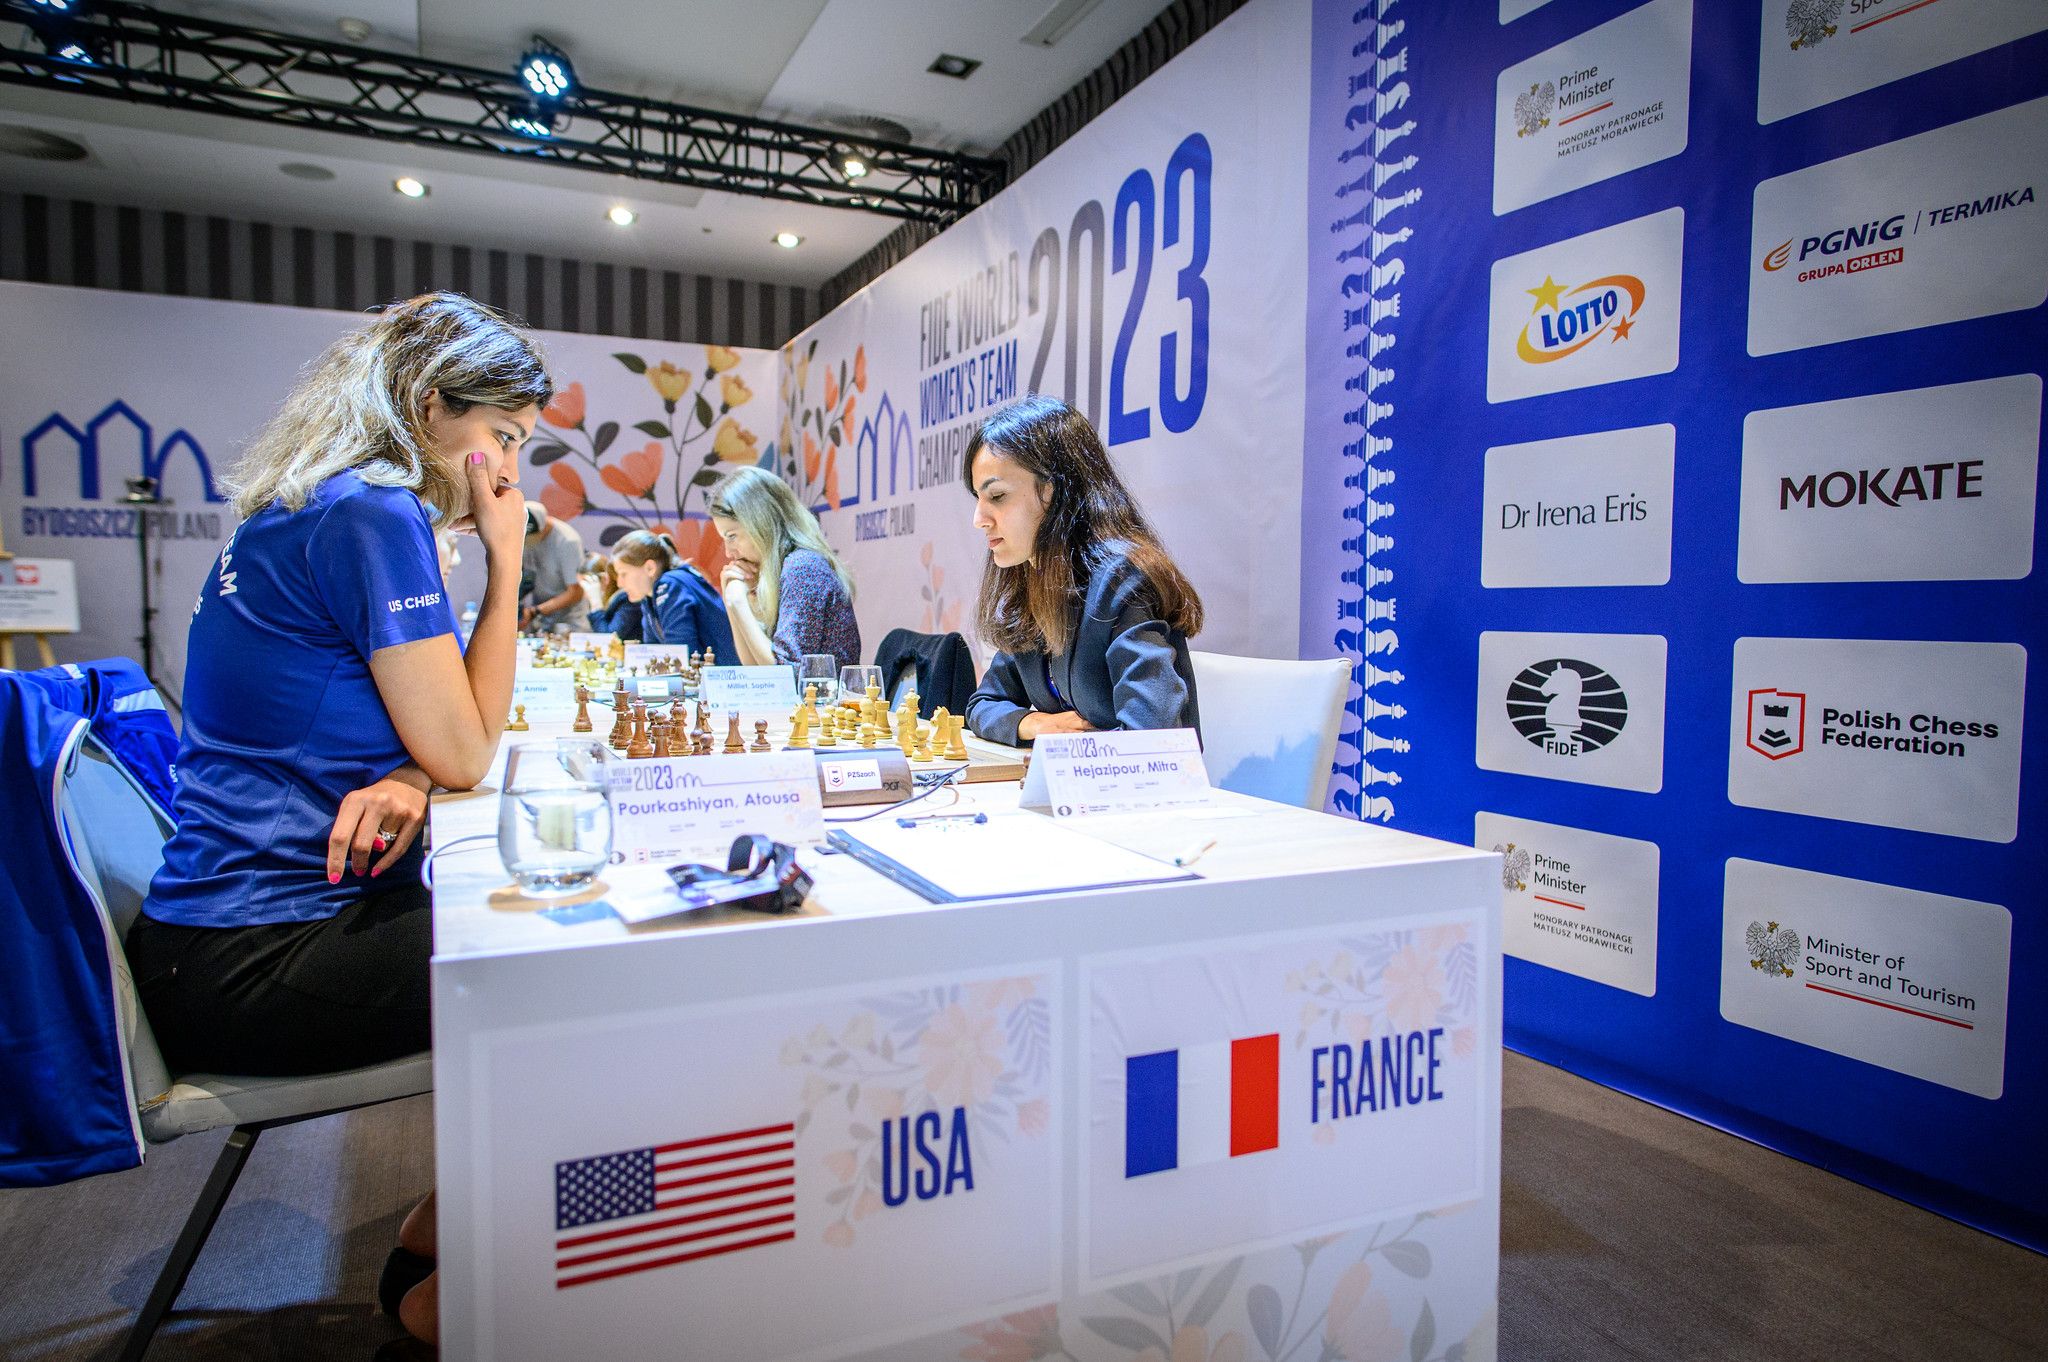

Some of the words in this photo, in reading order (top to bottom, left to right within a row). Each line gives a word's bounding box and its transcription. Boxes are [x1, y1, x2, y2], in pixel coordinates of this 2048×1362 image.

[1559, 78, 1615, 110] Minister
[1560, 66, 1598, 90] Prime
[1558, 124, 1606, 147] HONORARY
[1608, 101, 1664, 129] PATRONAGE
[1558, 137, 1598, 158] MATEUSZ
[1601, 112, 1664, 142] MORAWIECKI
[1799, 214, 1905, 262] PGNiG
[1928, 186, 2035, 227] TERMIKA
[1797, 263, 1845, 283] GRUPA
[1849, 250, 1901, 272] ORLEN
[1029, 131, 1213, 447] 2023
[920, 291, 950, 371] FIDE
[957, 250, 1020, 349] WORLD
[1541, 290, 1618, 348] LOTTO
[919, 354, 976, 430] WOMEN'S
[980, 338, 1018, 409] TEAM
[919, 420, 979, 490] CHAMPI
[1780, 459, 1985, 511] MOKATE
[1501, 503, 1531, 530] Dr
[1536, 501, 1597, 527] Irena
[1605, 492, 1648, 523] Eris
[388, 599, 403, 613] US
[404, 592, 441, 610] CHESS
[1822, 708, 1901, 731] Polish
[1909, 714, 1999, 738] Chess
[1068, 737, 1098, 759] 2023
[1545, 739, 1579, 758] FIDE
[1821, 727, 1966, 757] Federation
[634, 764, 674, 792] 2023
[1073, 762, 1145, 779] Hejazipour,
[1148, 760, 1179, 773] Mitra
[618, 796, 739, 816] Pourkashiyan,
[744, 791, 801, 807] Atousa
[1535, 853, 1571, 873] Prime
[1534, 871, 1587, 895] Minister
[1533, 911, 1579, 929] HONORARY
[1580, 924, 1633, 944] PATRONAGE
[1533, 922, 1571, 938] MATEUSZ
[1574, 932, 1633, 955] MORAWIECKI
[1806, 935, 1881, 965] Minister
[1885, 956, 1905, 971] of
[1805, 956, 1853, 981] Sport
[1858, 974, 1892, 990] and
[1897, 977, 1976, 1011] Tourism
[1311, 1027, 1444, 1124] FRANCE
[881, 1106, 975, 1208] USA
